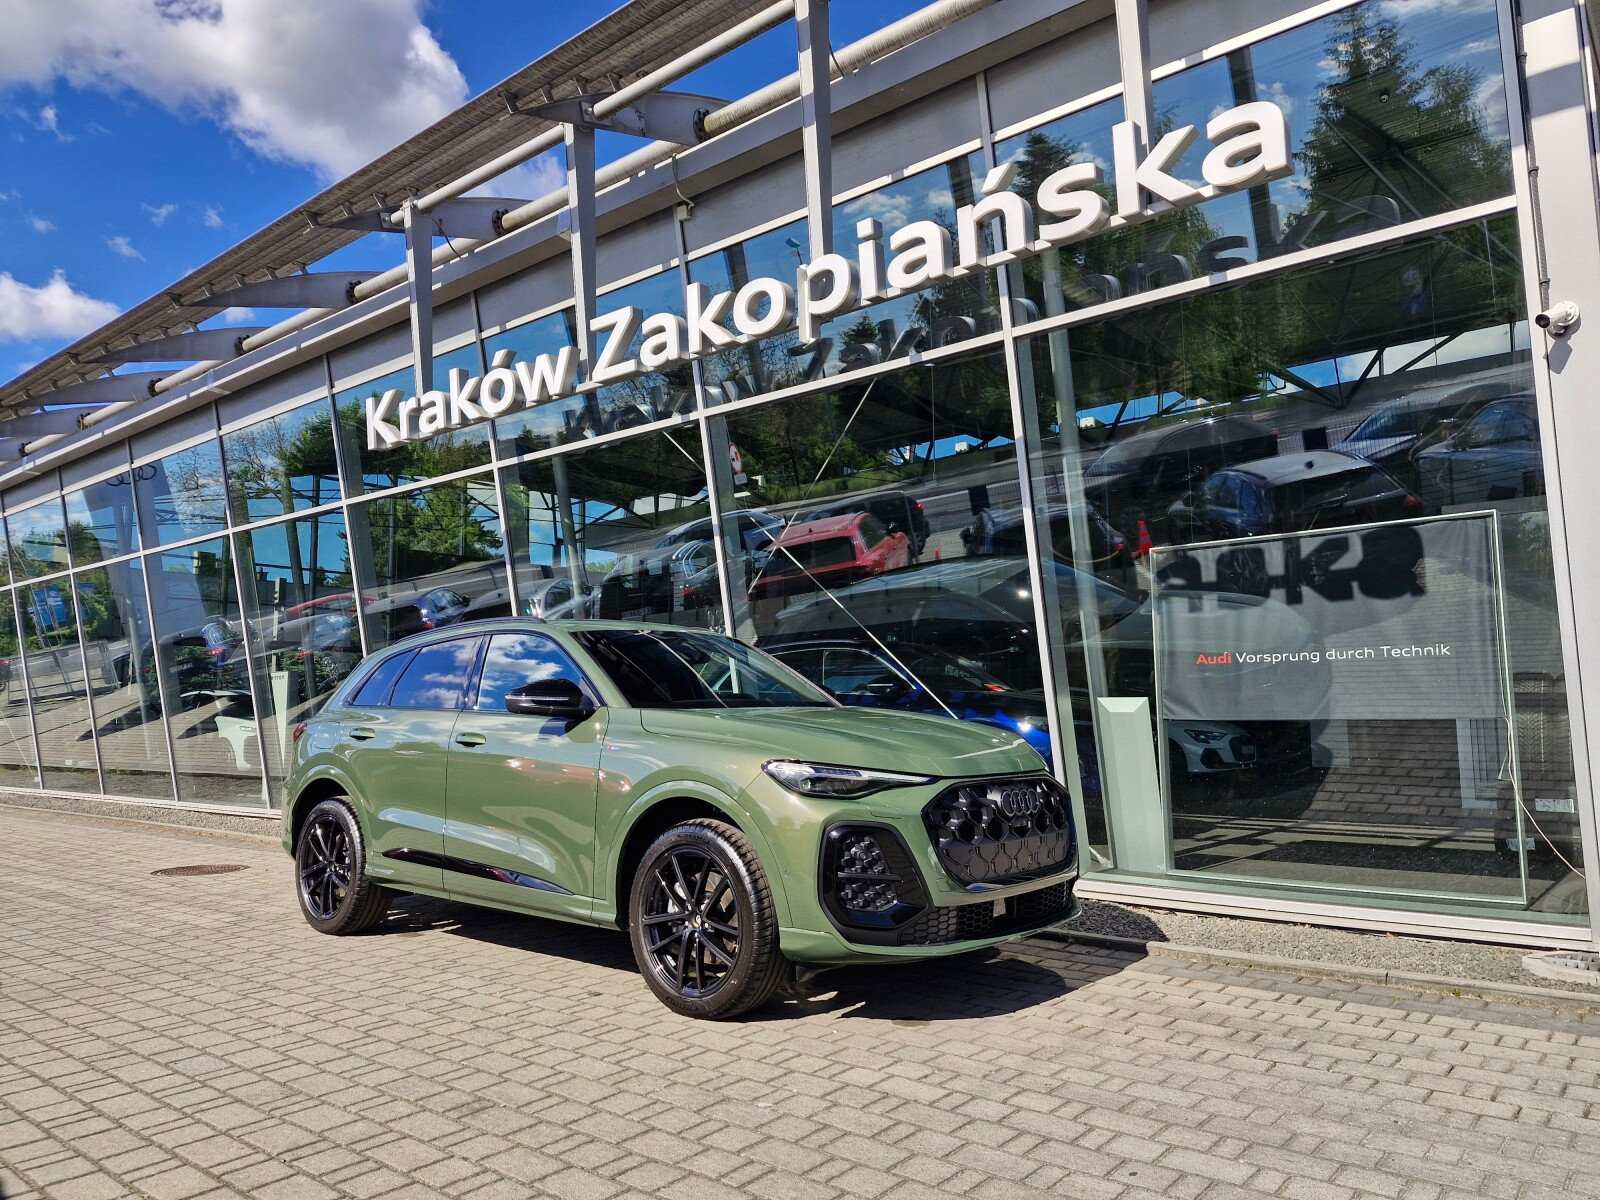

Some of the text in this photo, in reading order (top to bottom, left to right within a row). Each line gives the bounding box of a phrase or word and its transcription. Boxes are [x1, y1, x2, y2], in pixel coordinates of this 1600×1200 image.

[366, 101, 1294, 450] Kraków Zakopiańska
[1196, 643, 1452, 665] Audi Vorsprung durch Technik
